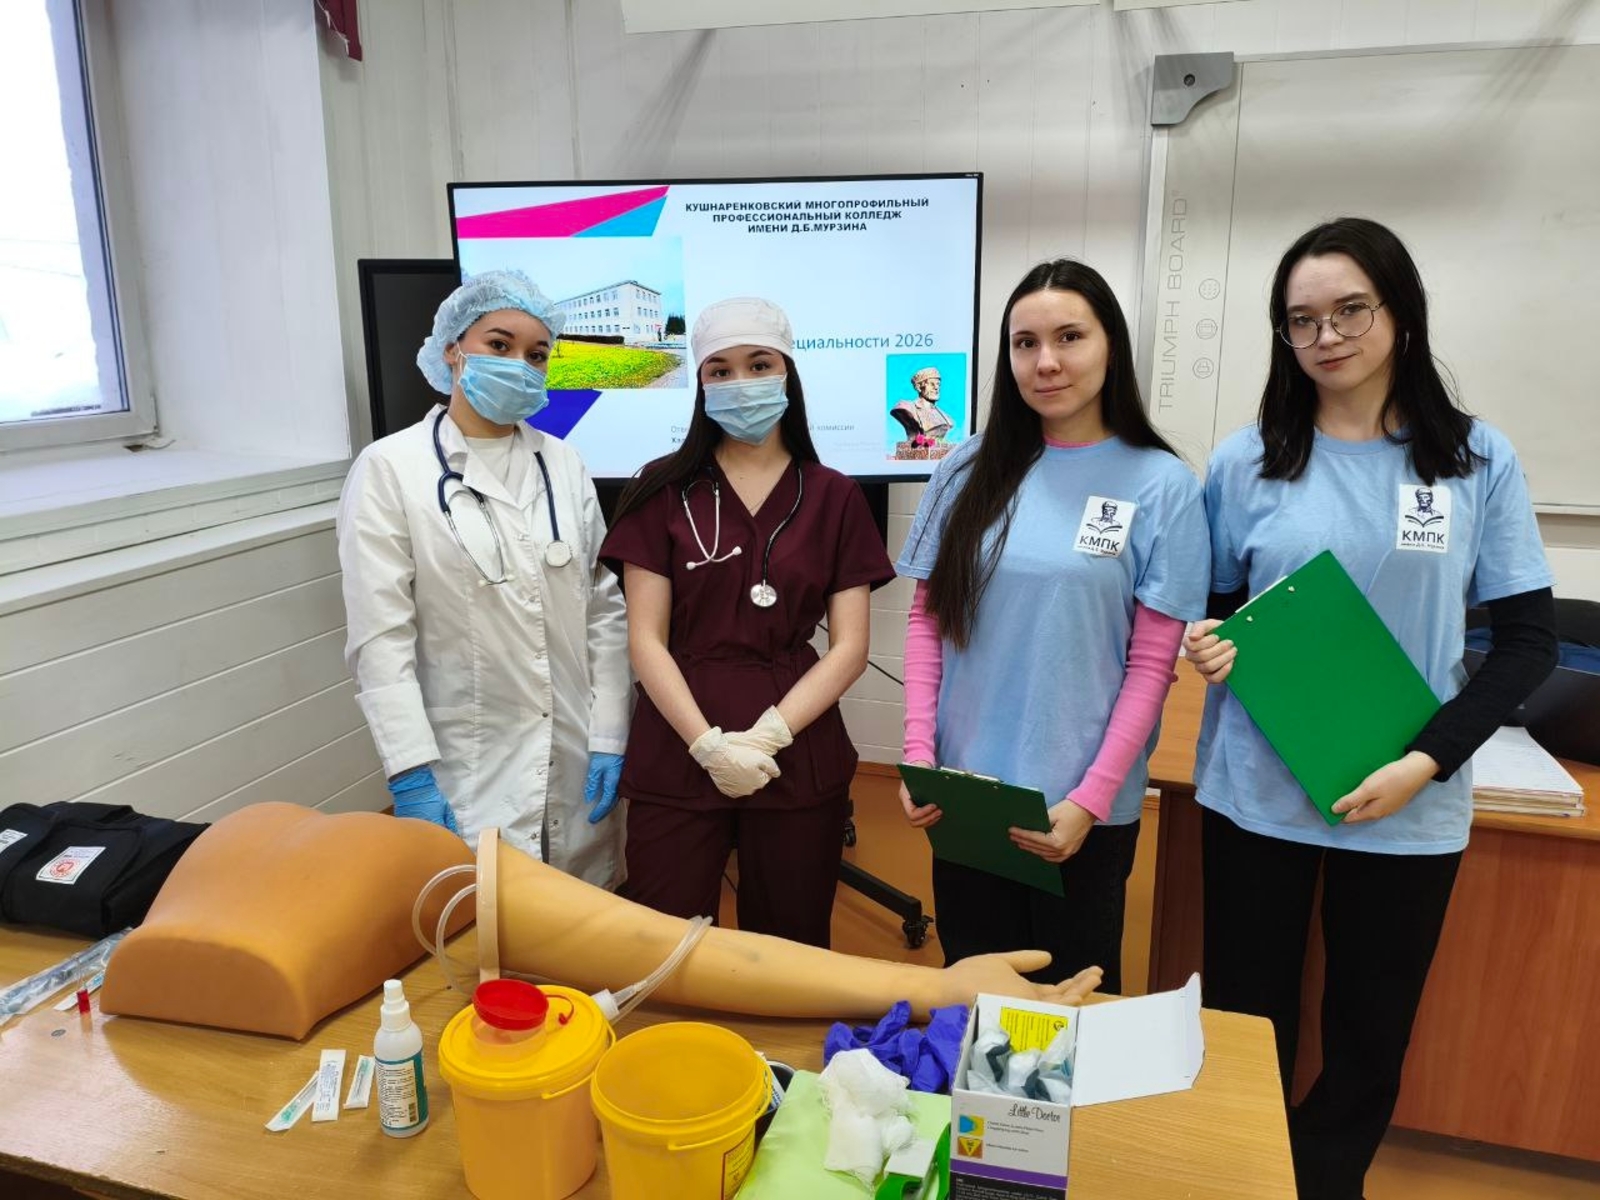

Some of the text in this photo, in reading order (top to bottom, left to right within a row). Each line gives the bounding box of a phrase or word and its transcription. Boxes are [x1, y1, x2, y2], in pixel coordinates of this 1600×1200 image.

[685, 198, 930, 212] КУШНАРЕНКОВСКИЙ МНОГОПРОФИЛЬНЫЙ
[713, 210, 902, 222] ПРОФЕССИОНАЛЬНЫЙ КОЛЛЕДЖ
[748, 222, 867, 233] ИМЕНИ Д.Б.МУРЗИНА
[790, 333, 934, 352] ециальности 2026
[1158, 301, 1181, 413] TRIUMPH
[1080, 535, 1120, 552] КМПК
[1402, 530, 1445, 545] КМПК
